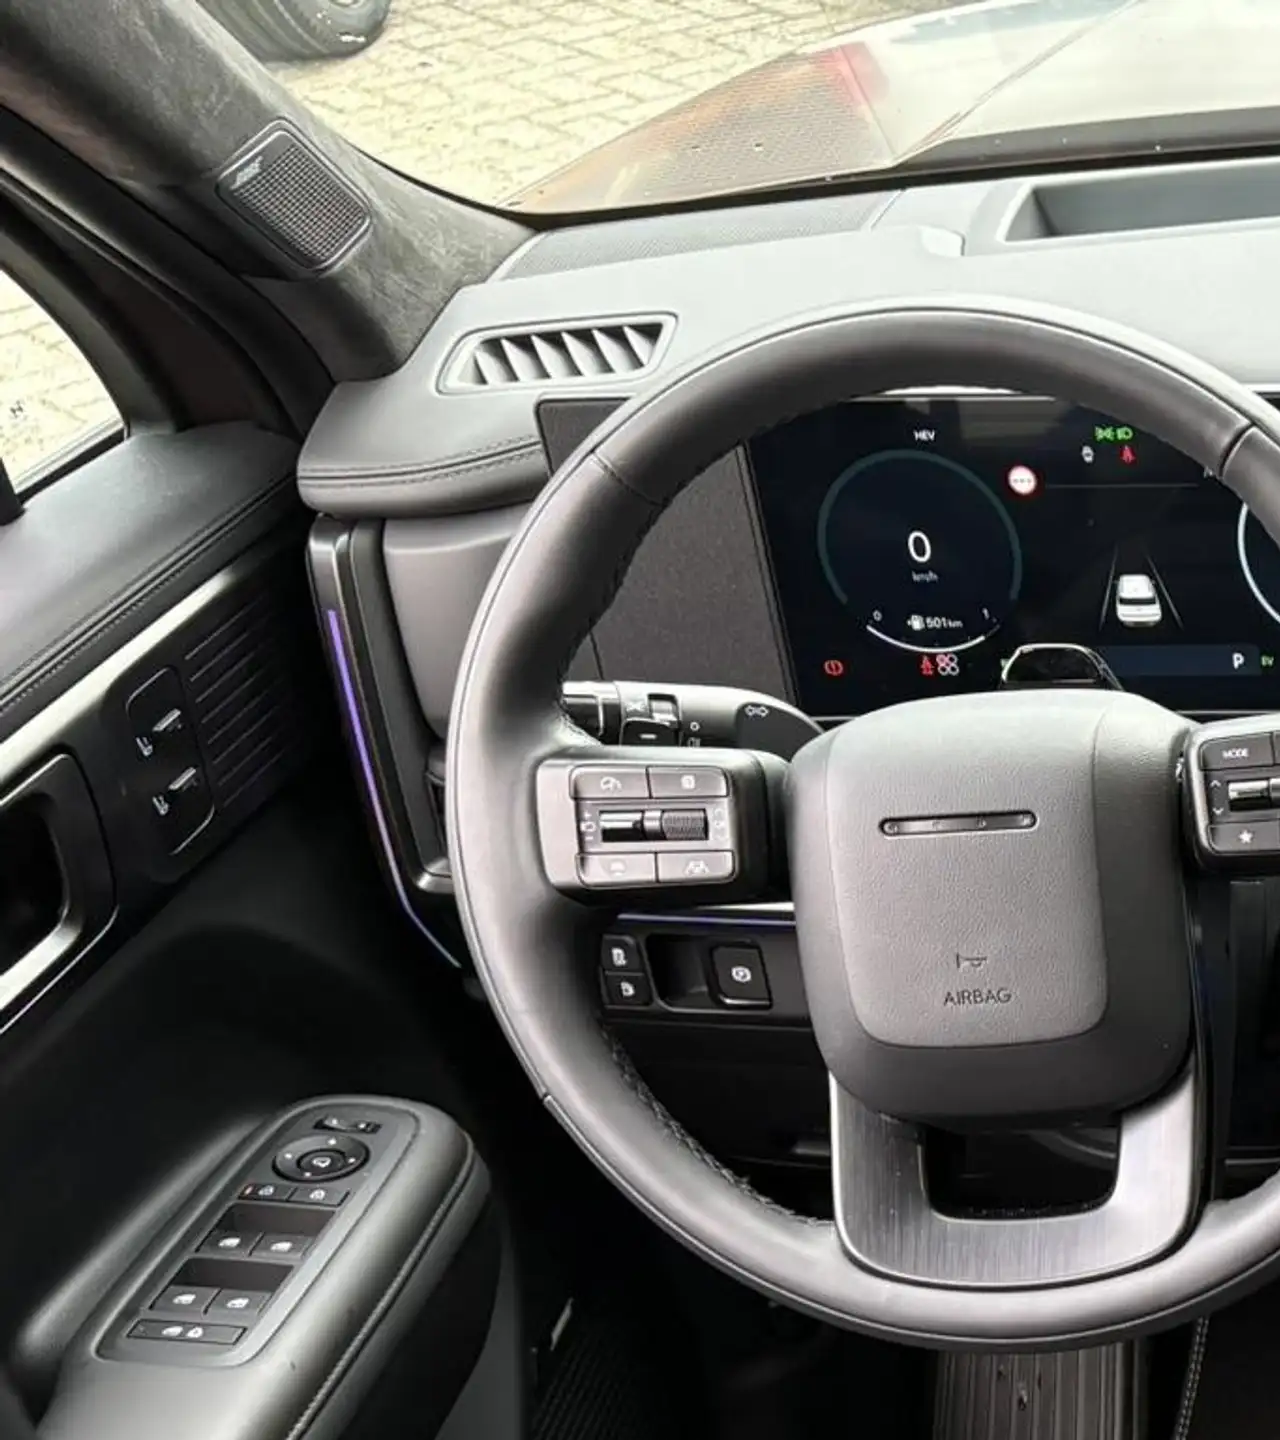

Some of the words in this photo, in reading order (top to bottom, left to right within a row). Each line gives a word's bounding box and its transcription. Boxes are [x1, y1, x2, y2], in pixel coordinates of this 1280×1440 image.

[907, 530, 932, 563] 0
[1231, 651, 1245, 670] P
[1221, 747, 1249, 760] MODE
[943, 987, 1012, 1006] AIRBAG
